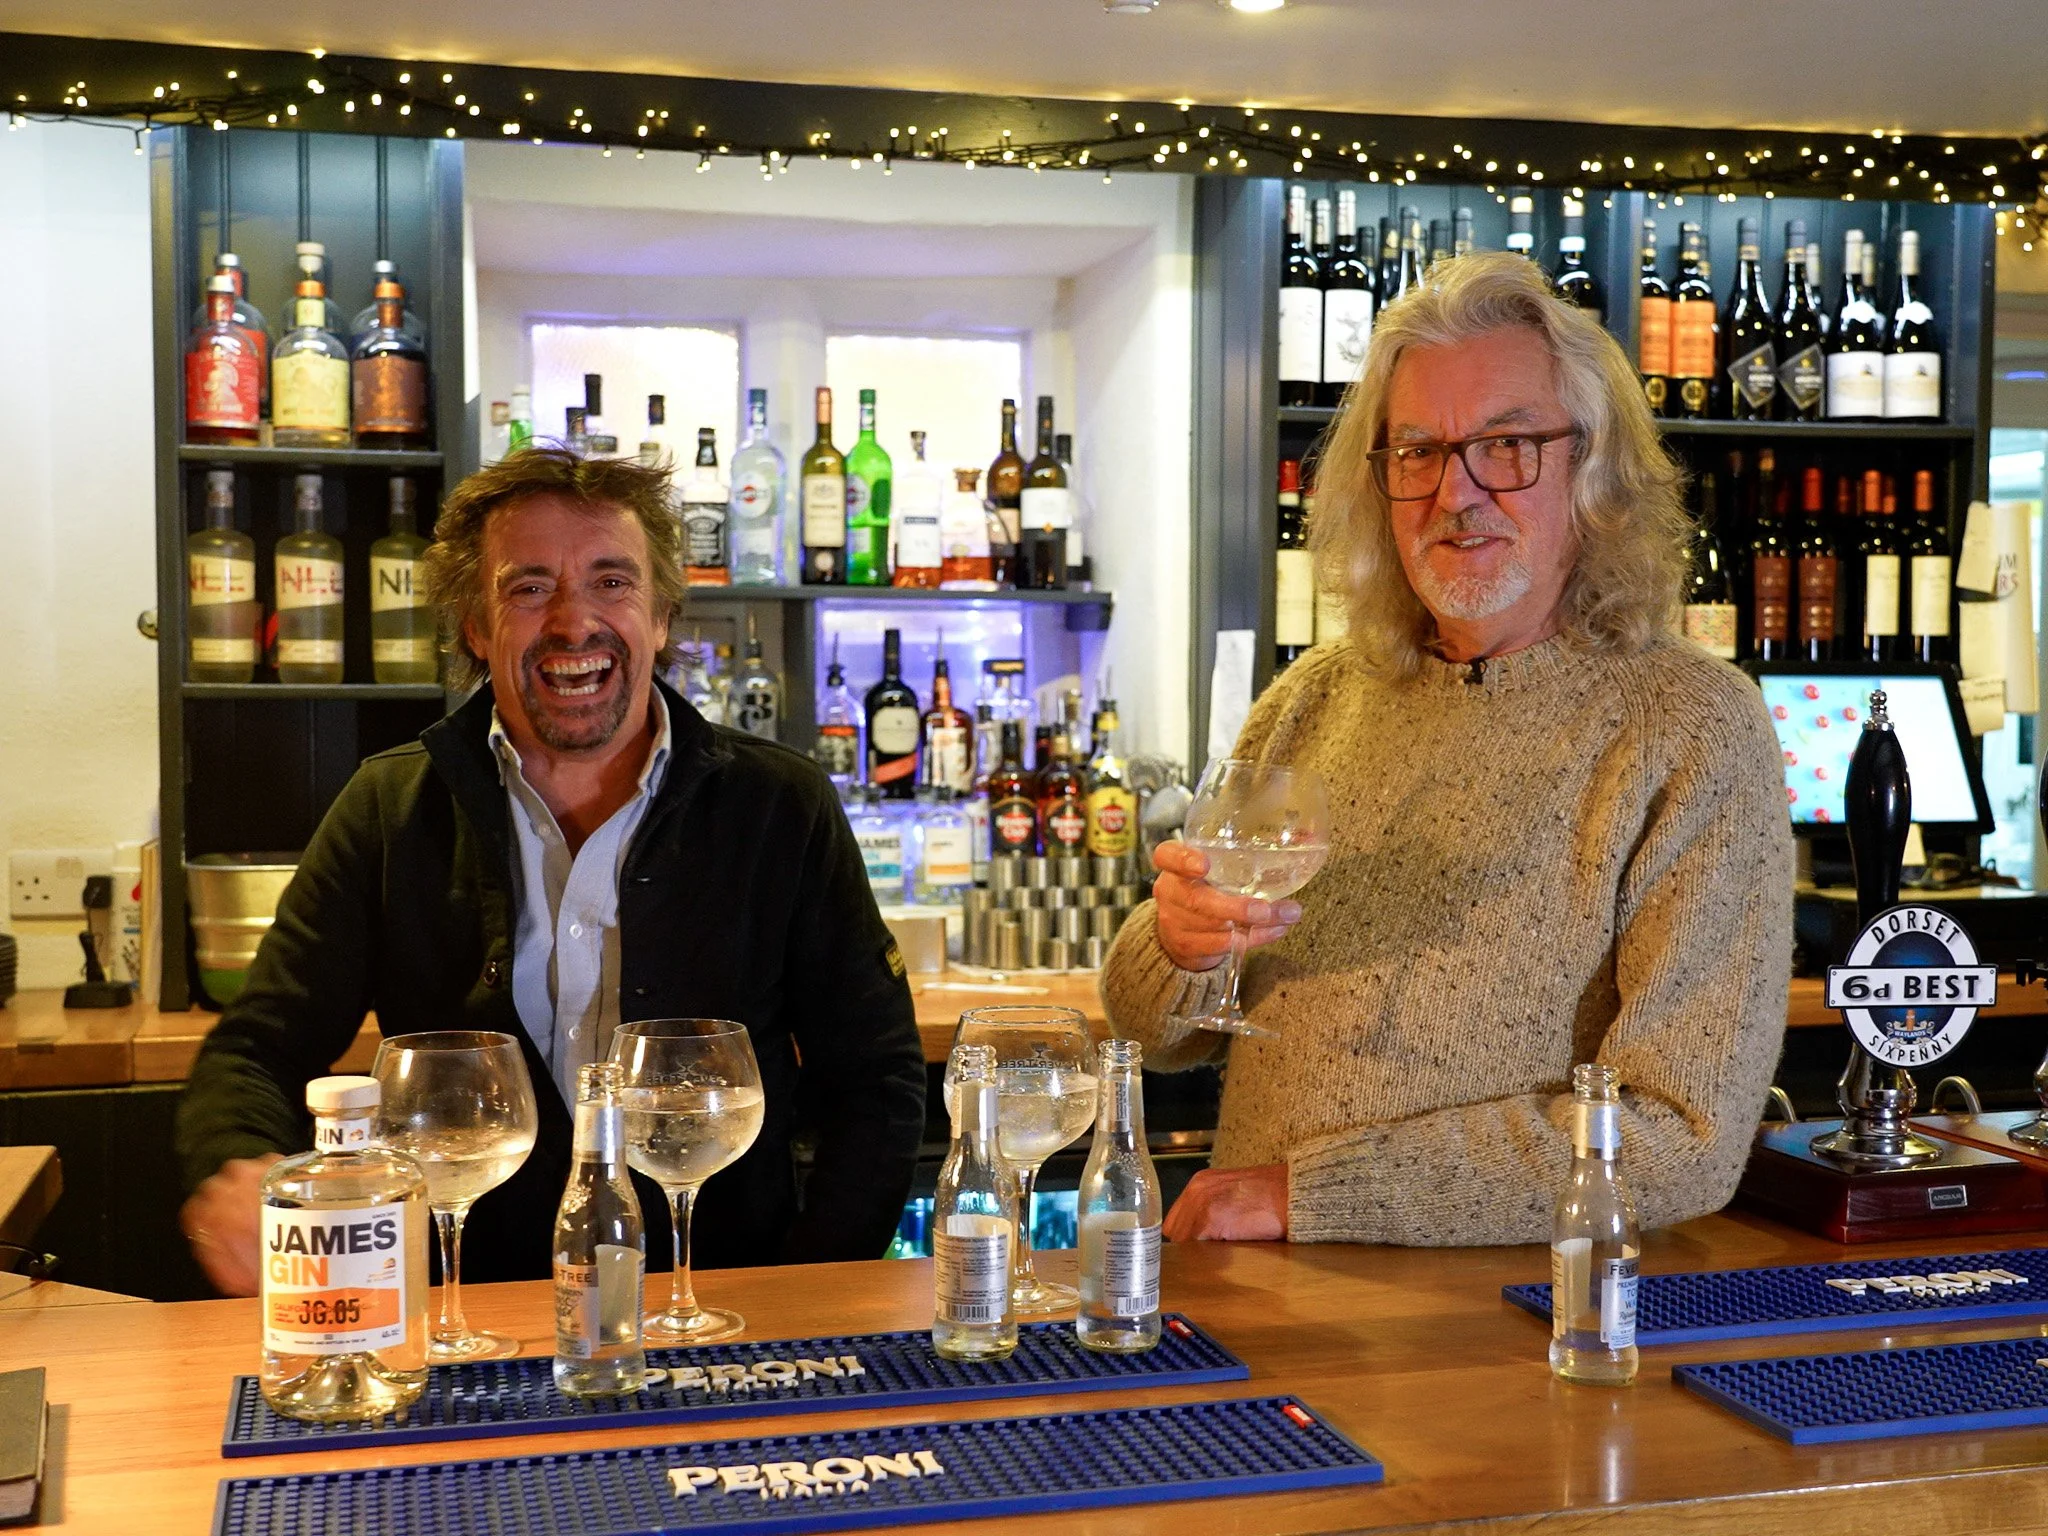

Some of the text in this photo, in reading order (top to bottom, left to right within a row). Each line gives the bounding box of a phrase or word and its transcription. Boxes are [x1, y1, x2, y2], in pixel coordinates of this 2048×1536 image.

[1871, 910, 1960, 944] DORSET
[1842, 975, 1979, 999] 6d BEST
[1869, 1034, 1952, 1062] SIXPENNY
[270, 1219, 397, 1255] JAMES
[270, 1254, 328, 1287] GIN
[1825, 1268, 2029, 1296] PERONI
[667, 1450, 944, 1498] PERONI
